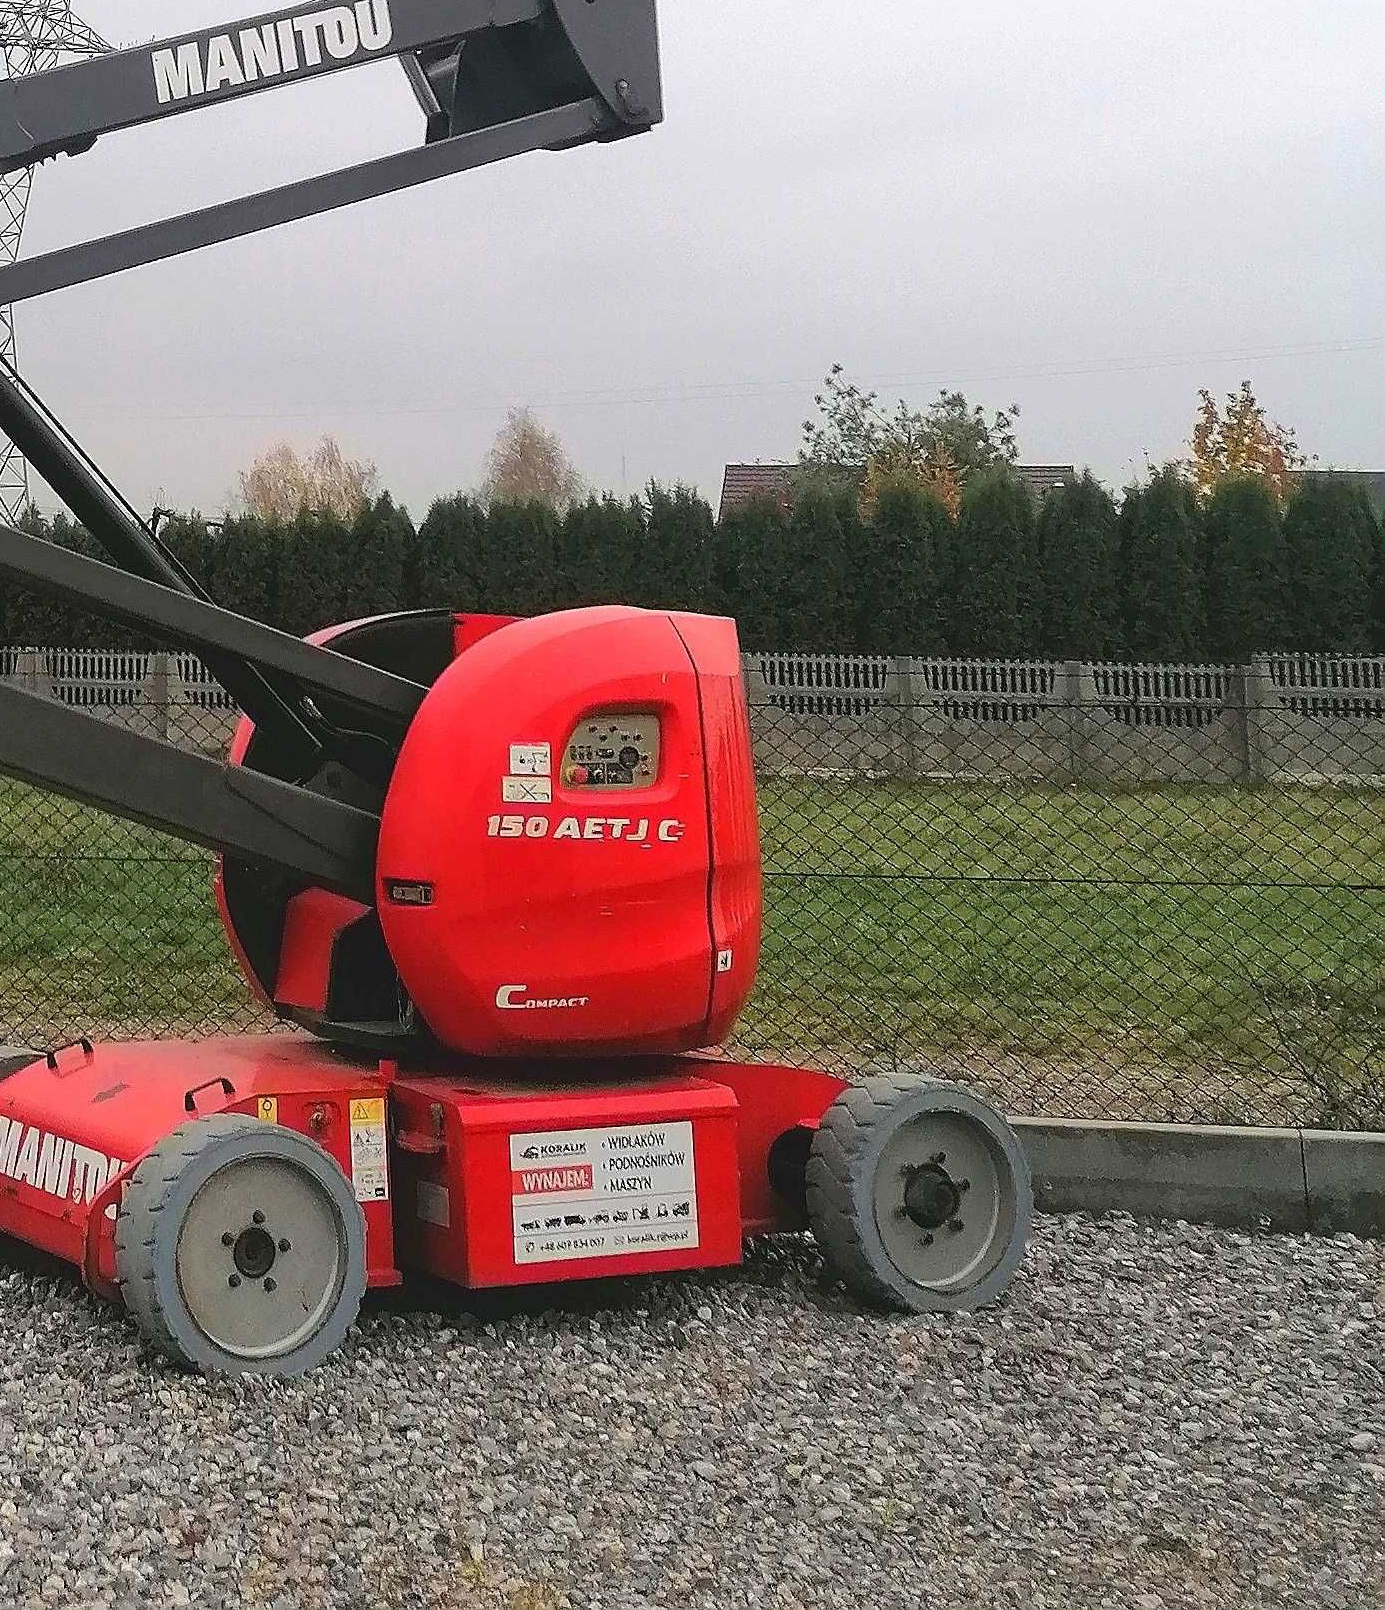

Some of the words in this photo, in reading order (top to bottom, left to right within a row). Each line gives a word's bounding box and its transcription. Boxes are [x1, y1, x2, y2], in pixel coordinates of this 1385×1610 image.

[487, 814, 549, 838] 150
[553, 816, 650, 841] AETJ
[540, 1142, 587, 1154] KORALIK
[607, 1131, 666, 1150] WIDŁAKÓW
[609, 1149, 686, 1171] PODNOŚNIKÓW
[521, 1167, 590, 1191] WYNAJEM:
[610, 1175, 652, 1192] MASZYN
